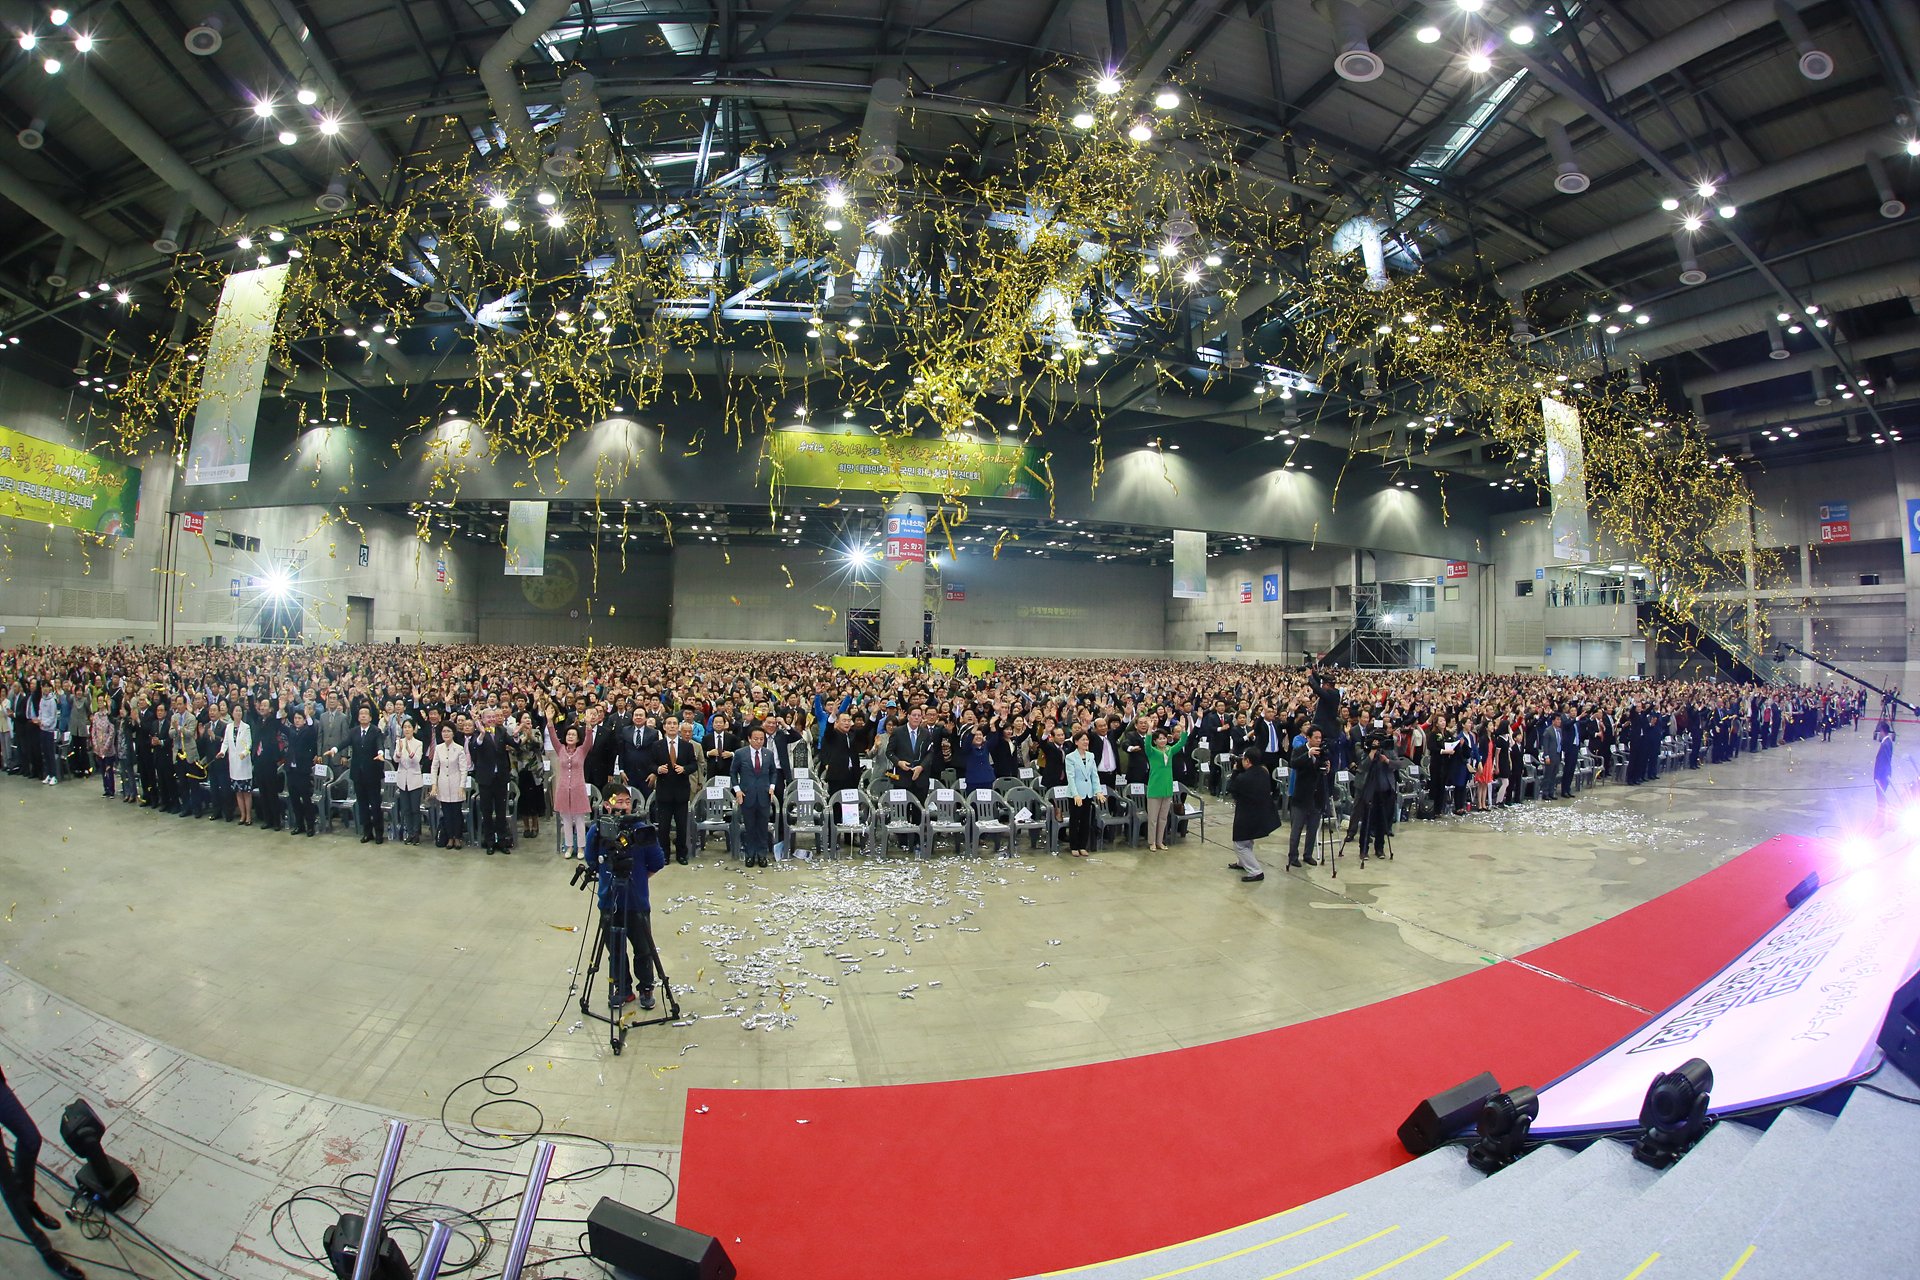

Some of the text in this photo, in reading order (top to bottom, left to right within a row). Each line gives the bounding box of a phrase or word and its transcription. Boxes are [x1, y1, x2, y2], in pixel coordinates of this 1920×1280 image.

[838, 463, 854, 474] 희망
[17, 480, 38, 499] 대국민
[38, 485, 53, 501] 화합
[53, 488, 67, 505] 통일
[68, 493, 94, 510] 전진대회
[1832, 525, 1848, 533] 소화기
[903, 542, 923, 551] 소화기
